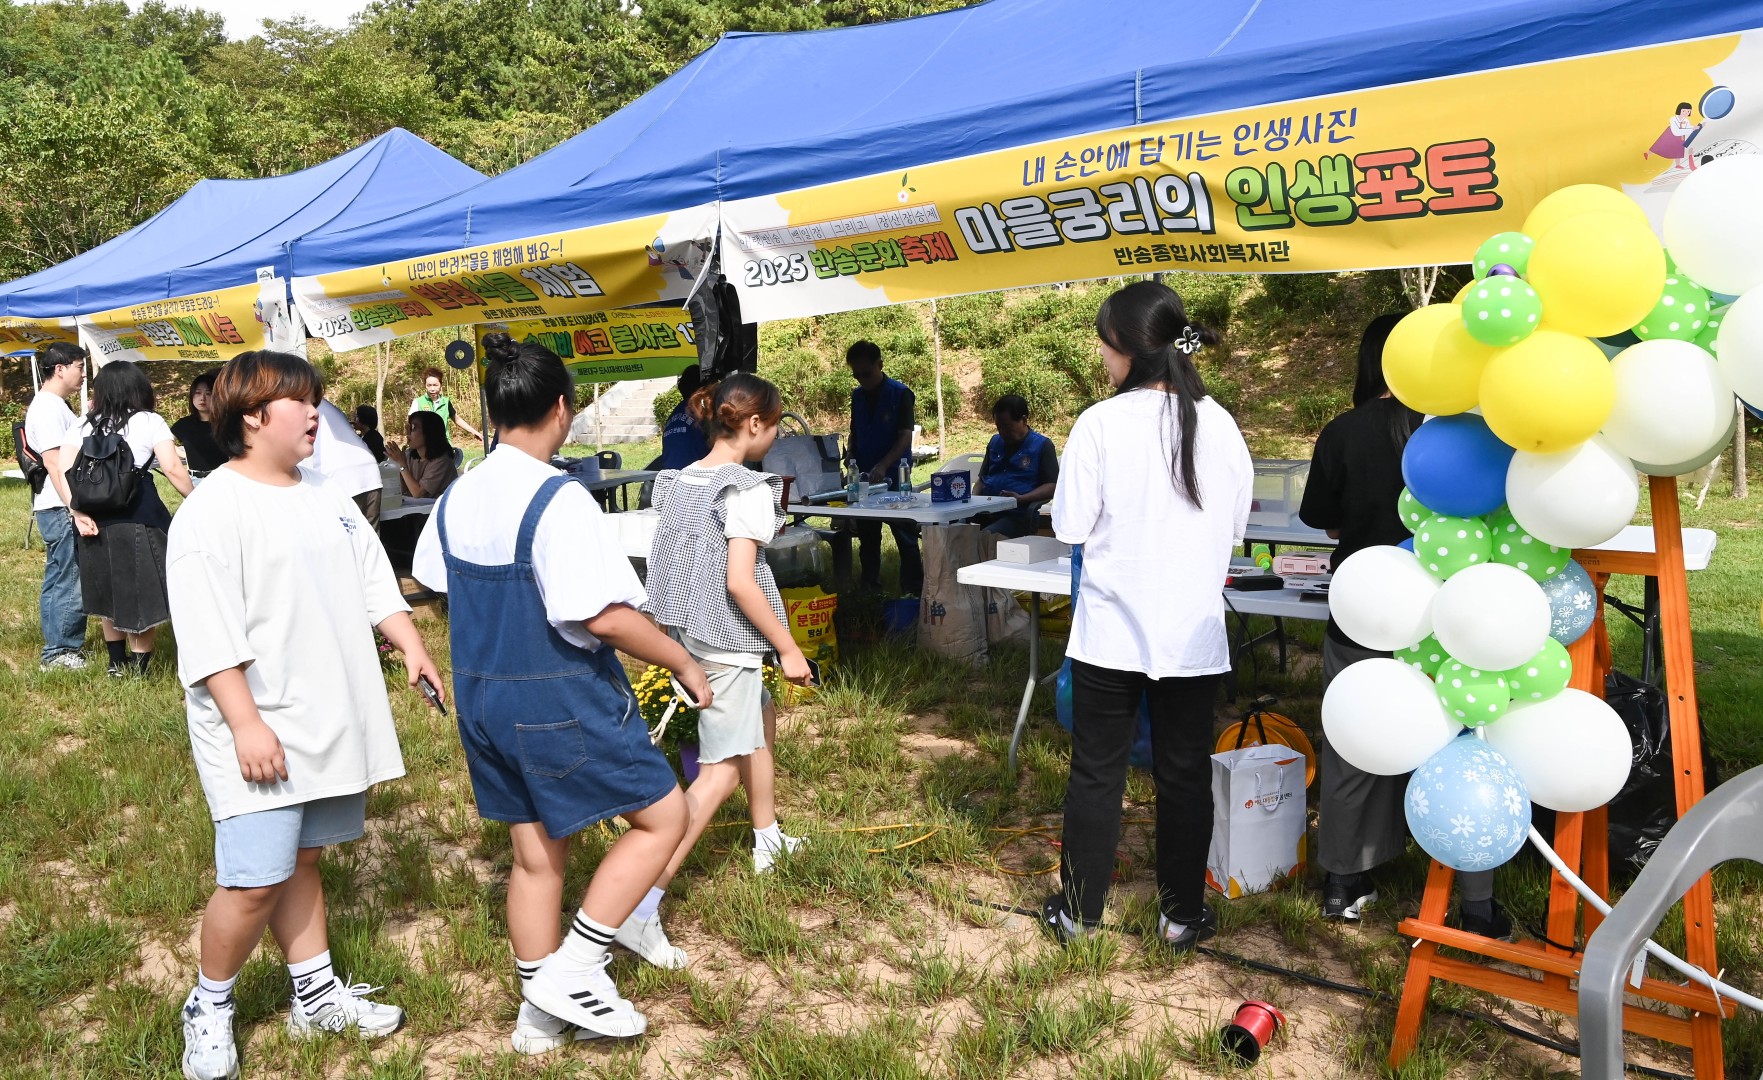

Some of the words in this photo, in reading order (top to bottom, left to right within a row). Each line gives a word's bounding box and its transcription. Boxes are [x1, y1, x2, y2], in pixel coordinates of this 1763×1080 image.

[1021, 158, 1046, 187] 내
[1053, 139, 1131, 183] 손안에
[1138, 129, 1223, 167] 담기는
[1233, 107, 1358, 156] 인생사진
[953, 171, 1217, 255] 마을궁리의
[1225, 137, 1504, 232] 인생포토
[790, 226, 823, 244] 백일장
[833, 217, 868, 234] 그리고
[877, 206, 939, 228] 장산장승제
[407, 259, 437, 281] 나만의
[439, 250, 489, 277] 반려식물을
[492, 244, 524, 268] 체험해
[744, 253, 809, 287] 2025
[808, 230, 960, 280] 반송문화축제
[1113, 240, 1291, 266] 반송종합사회복지관
[410, 271, 540, 310] 반려식물
[520, 261, 607, 298] 체험
[200, 311, 246, 345] 나눔
[312, 314, 354, 338] 2025
[349, 300, 434, 332] 반송문화축제
[481, 304, 548, 320] 바르게살기위원회
[573, 328, 614, 357] 에코
[608, 322, 682, 355] 봉사단
[797, 611, 830, 627] 분갈이
